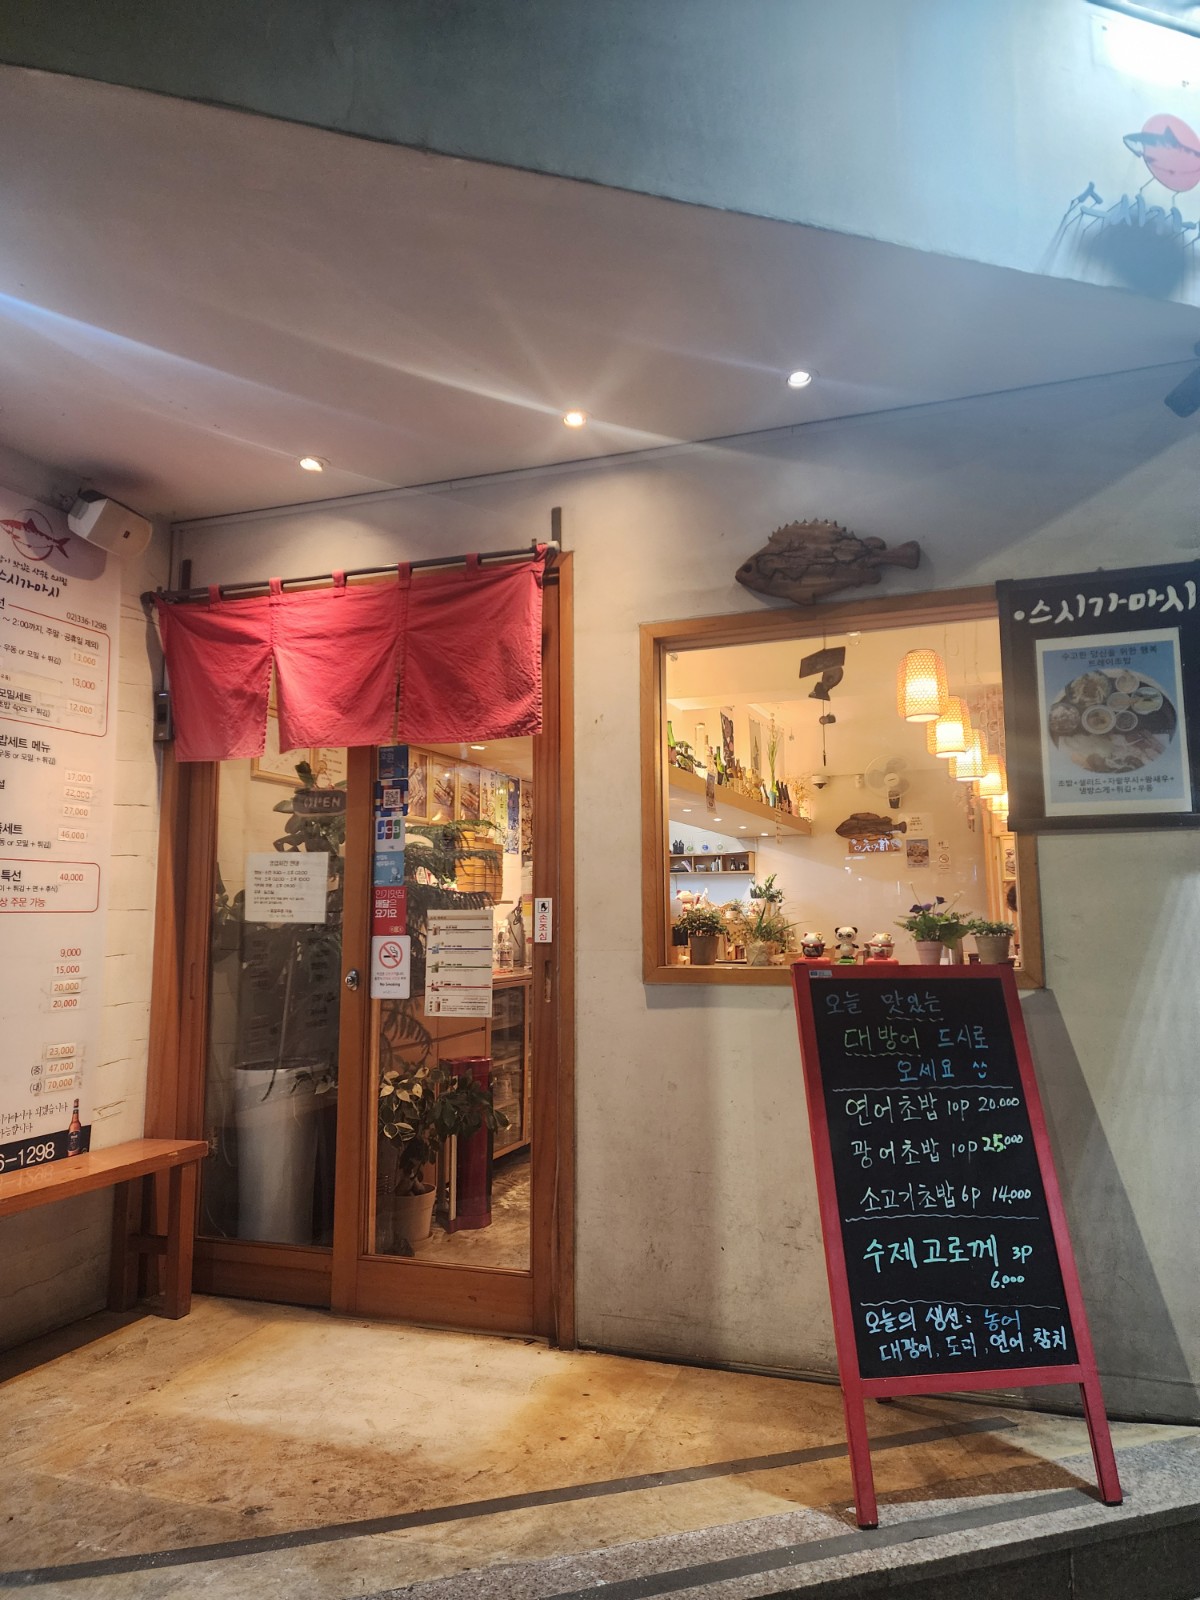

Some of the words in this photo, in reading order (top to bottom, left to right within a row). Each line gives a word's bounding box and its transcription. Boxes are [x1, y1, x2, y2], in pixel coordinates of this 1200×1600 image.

[1077, 181, 1200, 236] 스시가
[66, 611, 107, 631] 02)336-1298
[71, 677, 96, 691] 13,000
[31, 740, 51, 753] 메뉴
[303, 796, 341, 809] OPEN
[63, 806, 89, 817] 27,000
[60, 830, 85, 840] 46,000
[377, 825, 400, 834] JCB
[1, 869, 22, 882] 특선
[59, 873, 84, 883] 40,000
[10, 897, 27, 907] 주문
[29, 897, 46, 908] 가능
[374, 908, 397, 918] 요기요
[539, 914, 548, 941] 손조심
[60, 948, 82, 958] 9,000
[55, 965, 80, 975] 15,000
[53, 982, 80, 993] 20,000
[52, 998, 78, 1009] 20,000
[826, 991, 862, 1015] 오늘
[881, 990, 941, 1014] 맛있는
[844, 1025, 919, 1051] 대방어
[49, 1045, 75, 1057] 23,000
[48, 1062, 74, 1073] 47,000
[898, 1059, 955, 1082] 오세요
[47, 1078, 73, 1090] 70,000
[845, 1092, 938, 1126] 연어초밥
[851, 1137, 940, 1168] 광어초밥
[860, 1179, 956, 1212] 소고기초밥
[865, 1307, 917, 1334] 오늘의
[984, 1308, 1021, 1331] 농어
[1033, 1325, 1067, 1351] 참치
